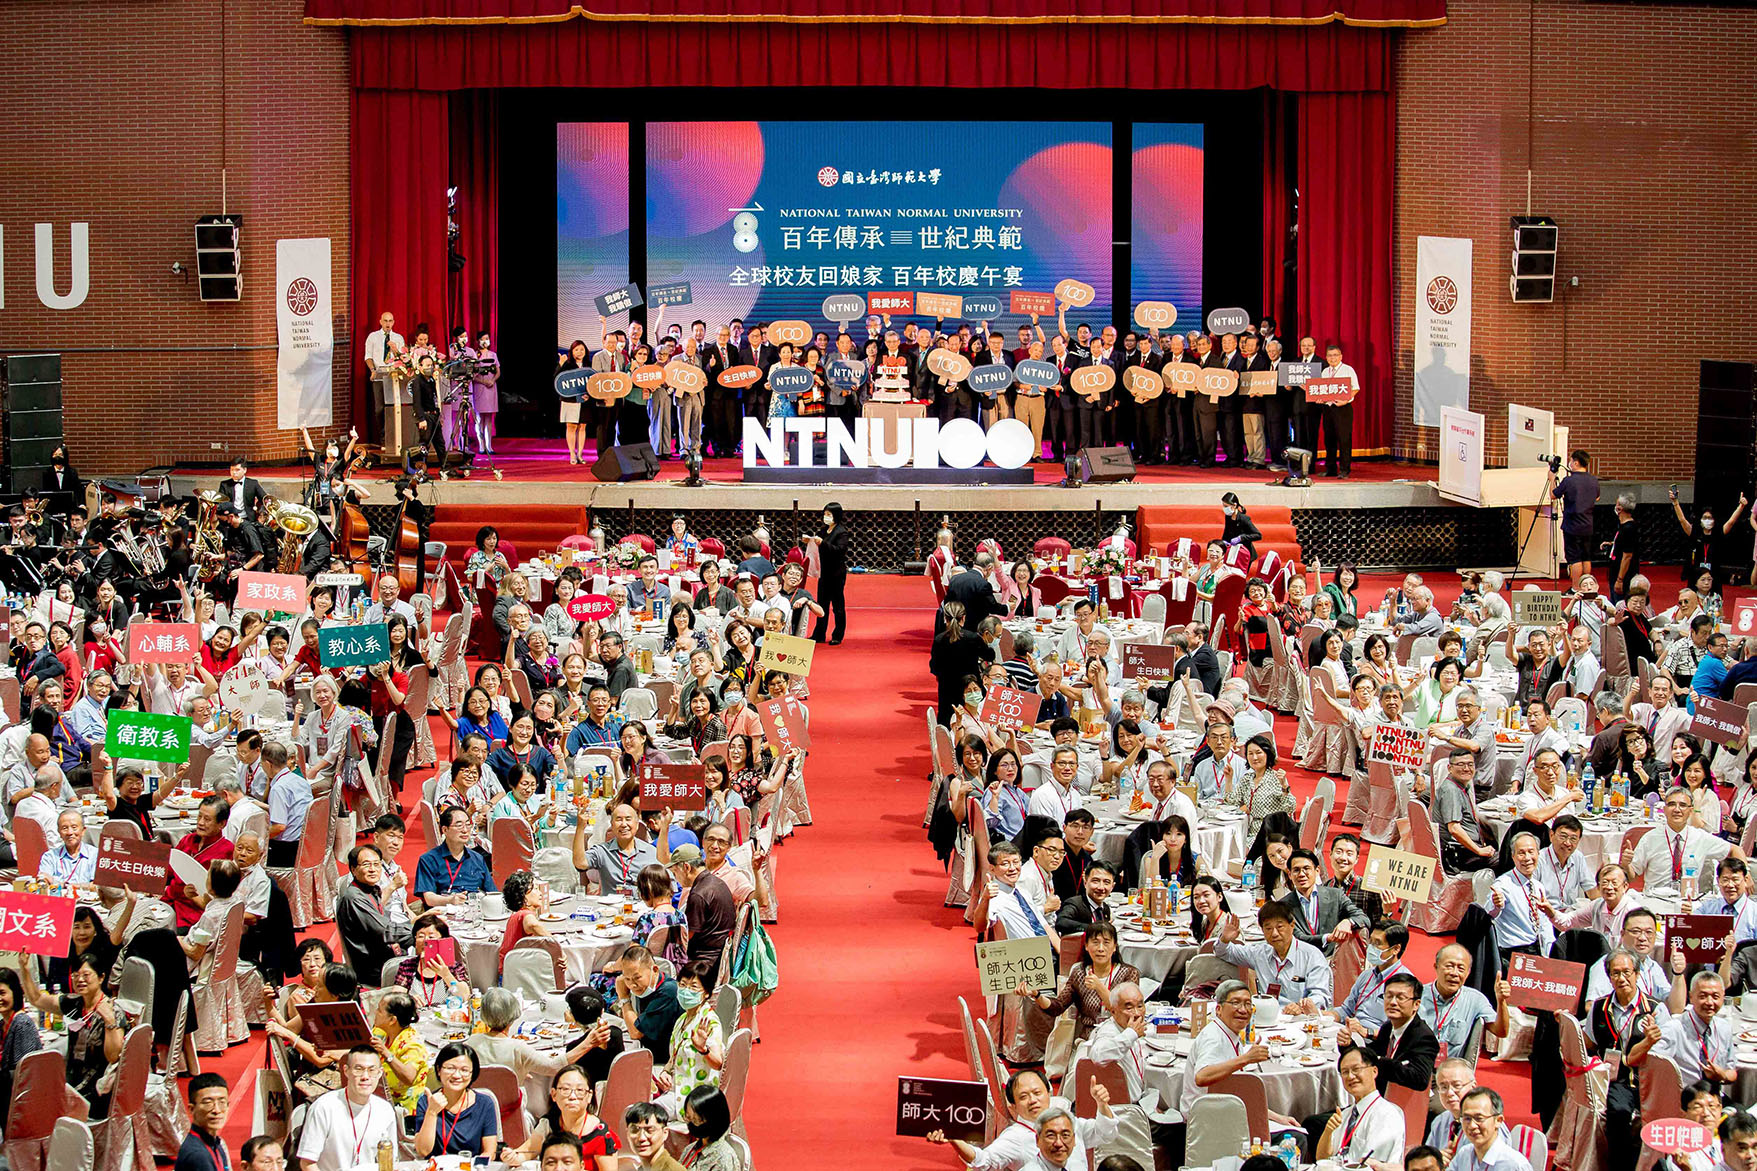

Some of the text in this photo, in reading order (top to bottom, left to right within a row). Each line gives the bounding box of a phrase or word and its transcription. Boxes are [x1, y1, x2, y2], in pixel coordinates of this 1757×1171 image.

[780, 208, 1024, 218] NATIONAL TAIWAN NORMAL UNIVERSITY
[780, 225, 1023, 250] 百年傳承 世紀典範
[728, 264, 1024, 287] 全球校友回娘家 百年校慶午宴
[1063, 285, 1087, 301] 100
[829, 303, 858, 313] NTNU
[871, 298, 910, 309] 我愛師大
[965, 304, 996, 313] NTNU
[1143, 308, 1169, 322] 100
[1213, 316, 1243, 326] NTNU
[776, 327, 804, 341] 100
[936, 355, 962, 375] 100
[672, 368, 698, 386] 100
[723, 371, 757, 384] 生日快樂
[833, 368, 862, 378] NTNU
[975, 372, 1006, 384] NTNU
[1022, 367, 1054, 380] NTNU
[1080, 371, 1107, 388] 100
[1170, 369, 1196, 384] 100
[596, 379, 623, 392] 100
[776, 375, 808, 386] NTNU
[1132, 373, 1156, 392] 100
[1204, 375, 1230, 389] 100
[1308, 383, 1349, 395] 我愛師大
[247, 581, 297, 601] 家政系
[572, 601, 612, 614] 我愛師大
[1526, 604, 1559, 612] BIRTHDAY
[1529, 613, 1538, 621] TO
[1539, 613, 1557, 621] NTNU
[138, 634, 190, 653] 心輔系
[328, 635, 382, 657] 教心系
[787, 655, 807, 667] 師大
[1128, 656, 1146, 664] 師大
[1137, 667, 1170, 677] 生日快樂
[1000, 689, 1024, 705] 師大
[997, 701, 1022, 717] 100
[116, 724, 179, 749] 衛教系
[1374, 741, 1404, 755] NTNU
[643, 783, 703, 798] 我愛師大
[98, 857, 166, 878] 師大生日快樂
[1388, 859, 1428, 879] WE ARE
[1389, 875, 1419, 892] NTNU
[0, 908, 56, 939] 文系
[1650, 1124, 1704, 1148] 生日快樂
